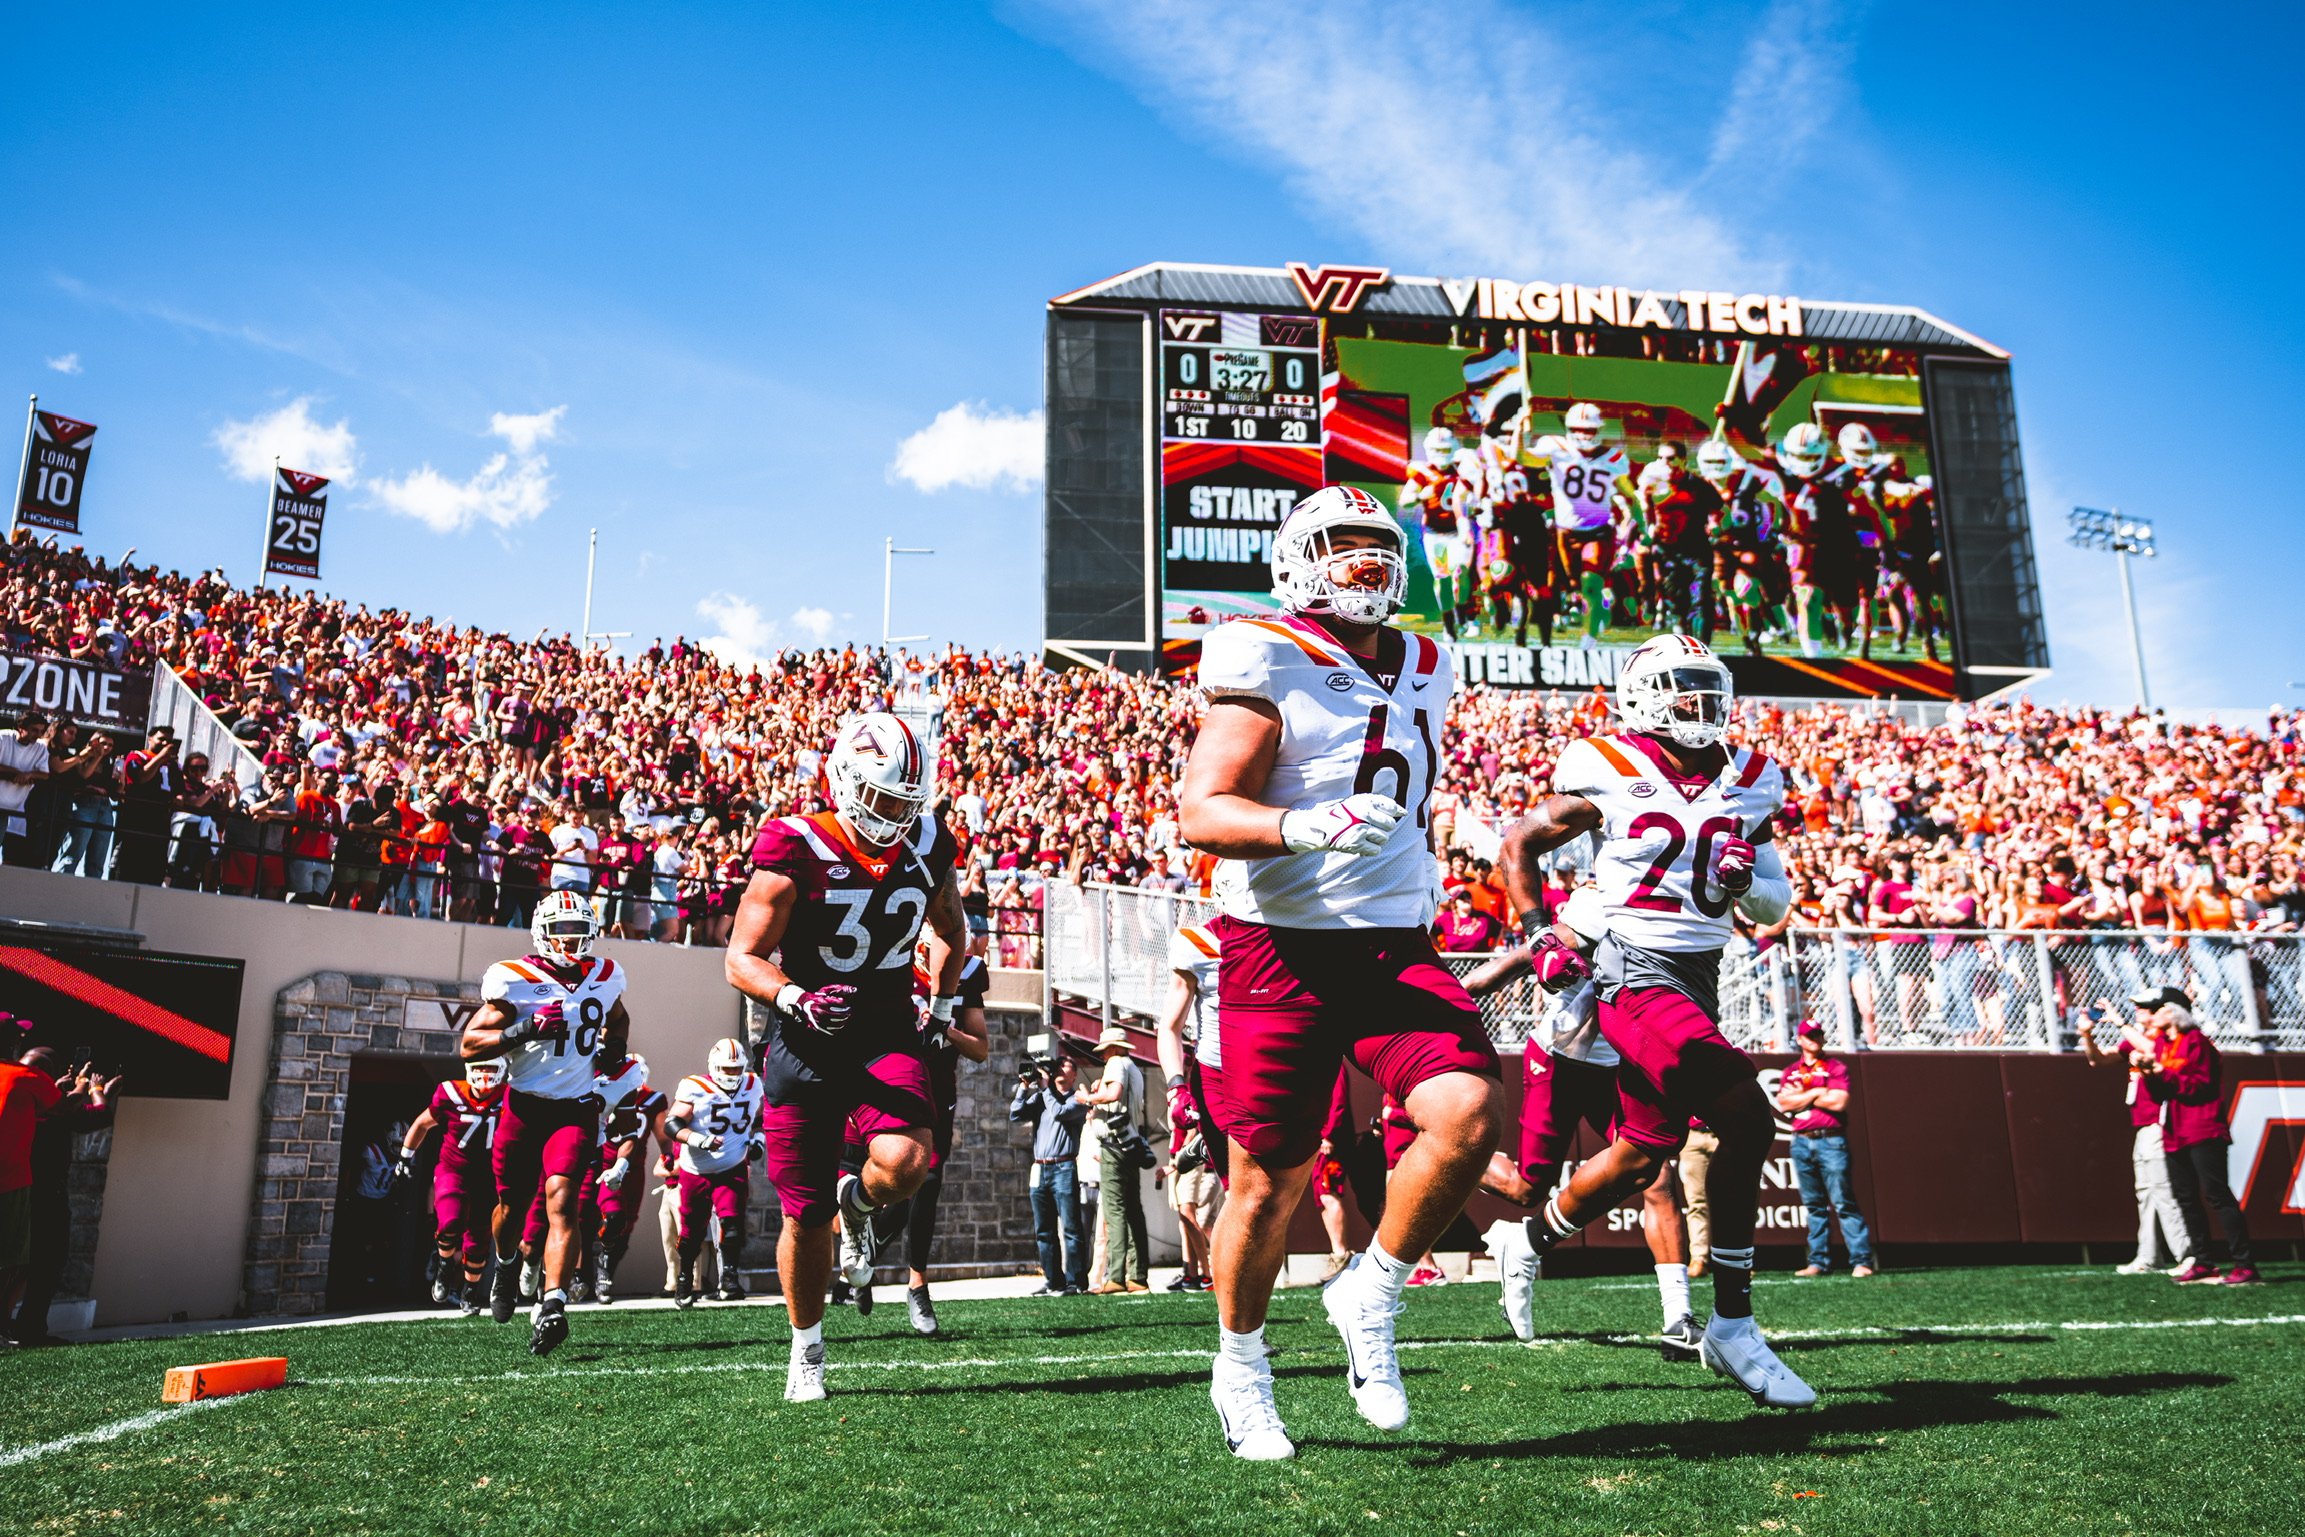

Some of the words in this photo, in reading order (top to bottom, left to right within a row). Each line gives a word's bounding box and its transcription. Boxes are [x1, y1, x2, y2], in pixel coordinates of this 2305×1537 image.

[1286, 262, 1389, 313] VT
[1440, 277, 1673, 330] VIRGINIA
[1678, 290, 1803, 337] TECH
[1165, 317, 1216, 341] VT
[1263, 319, 1315, 345] VT
[1180, 353, 1198, 384] 0
[1217, 369, 1268, 391] 3:27
[1286, 358, 1304, 390] 0
[55, 419, 81, 434] VT
[1175, 416, 1210, 437] 1ST
[1231, 419, 1257, 440] 10
[1281, 421, 1308, 441] 20
[40, 448, 76, 471] LORIA
[36, 466, 74, 507] 10
[293, 472, 316, 485] VT
[1563, 465, 1611, 503] 85
[276, 498, 322, 519] BEAMER
[1189, 485, 1297, 522] START
[23, 511, 75, 529] HOKIES
[273, 515, 320, 554] 25
[1166, 526, 1277, 564] JUMPI
[270, 560, 316, 575] HOKIES
[1377, 673, 1396, 687] VT
[1449, 646, 1535, 684] NTER
[1353, 703, 1437, 829] 61
[1680, 783, 1703, 796] VT
[870, 863, 889, 874] VT
[1623, 811, 1735, 919] 20
[818, 886, 928, 973] 32
[551, 997, 604, 1057] 48
[458, 1114, 496, 1149] 71
[708, 1101, 751, 1135] 53
